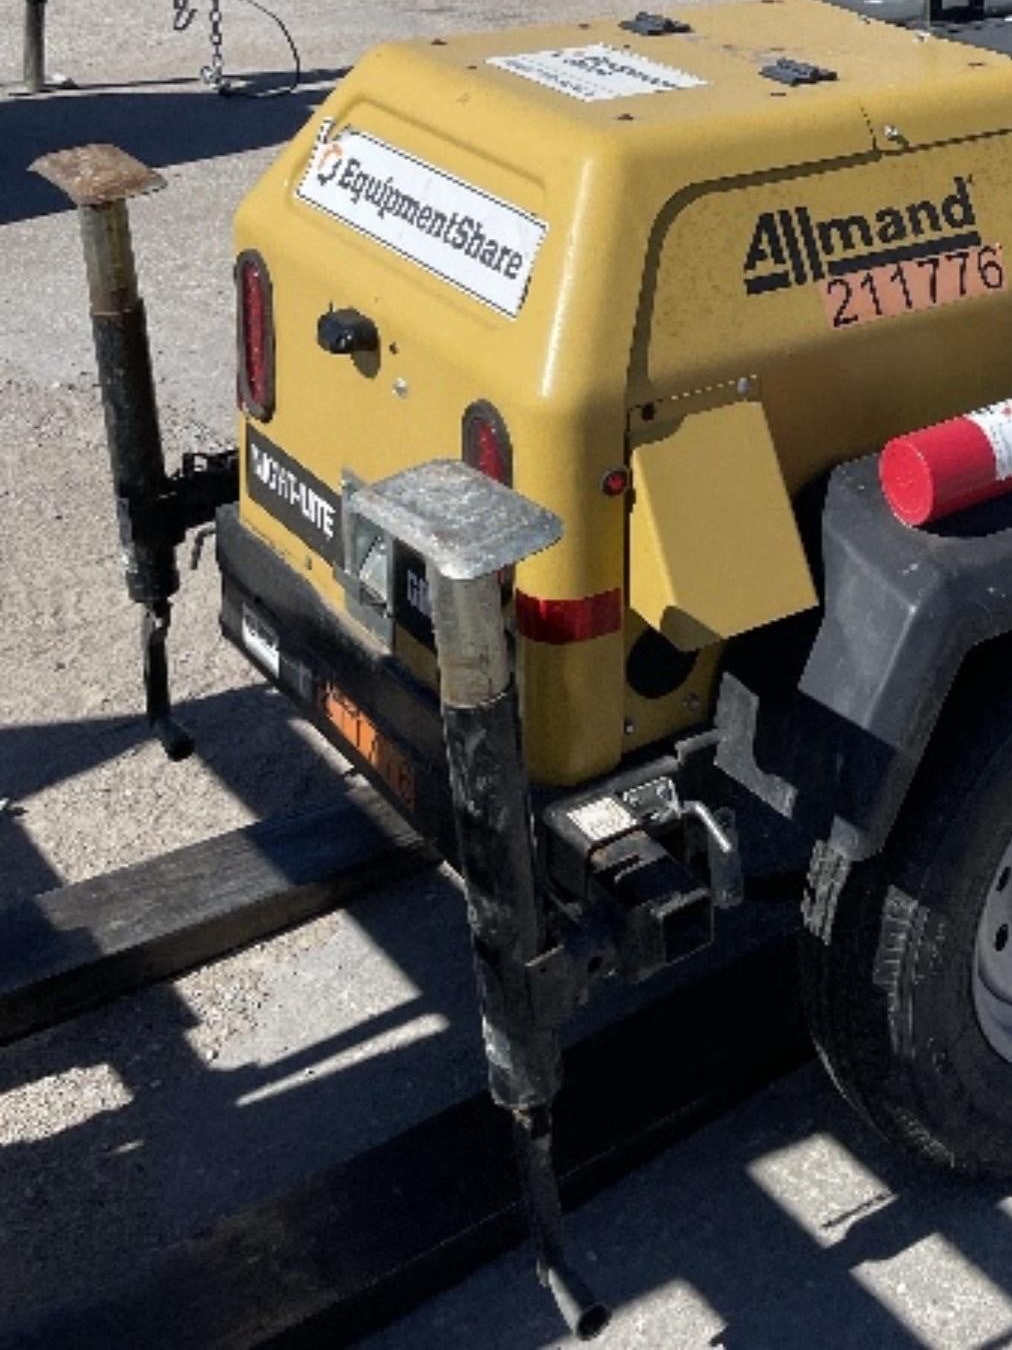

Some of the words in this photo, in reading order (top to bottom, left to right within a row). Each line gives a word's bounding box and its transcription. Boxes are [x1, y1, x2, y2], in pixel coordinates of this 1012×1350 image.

[340, 157, 523, 280] EquipmentShare
[744, 176, 976, 286] Allmand
[827, 246, 1003, 327] 211776
